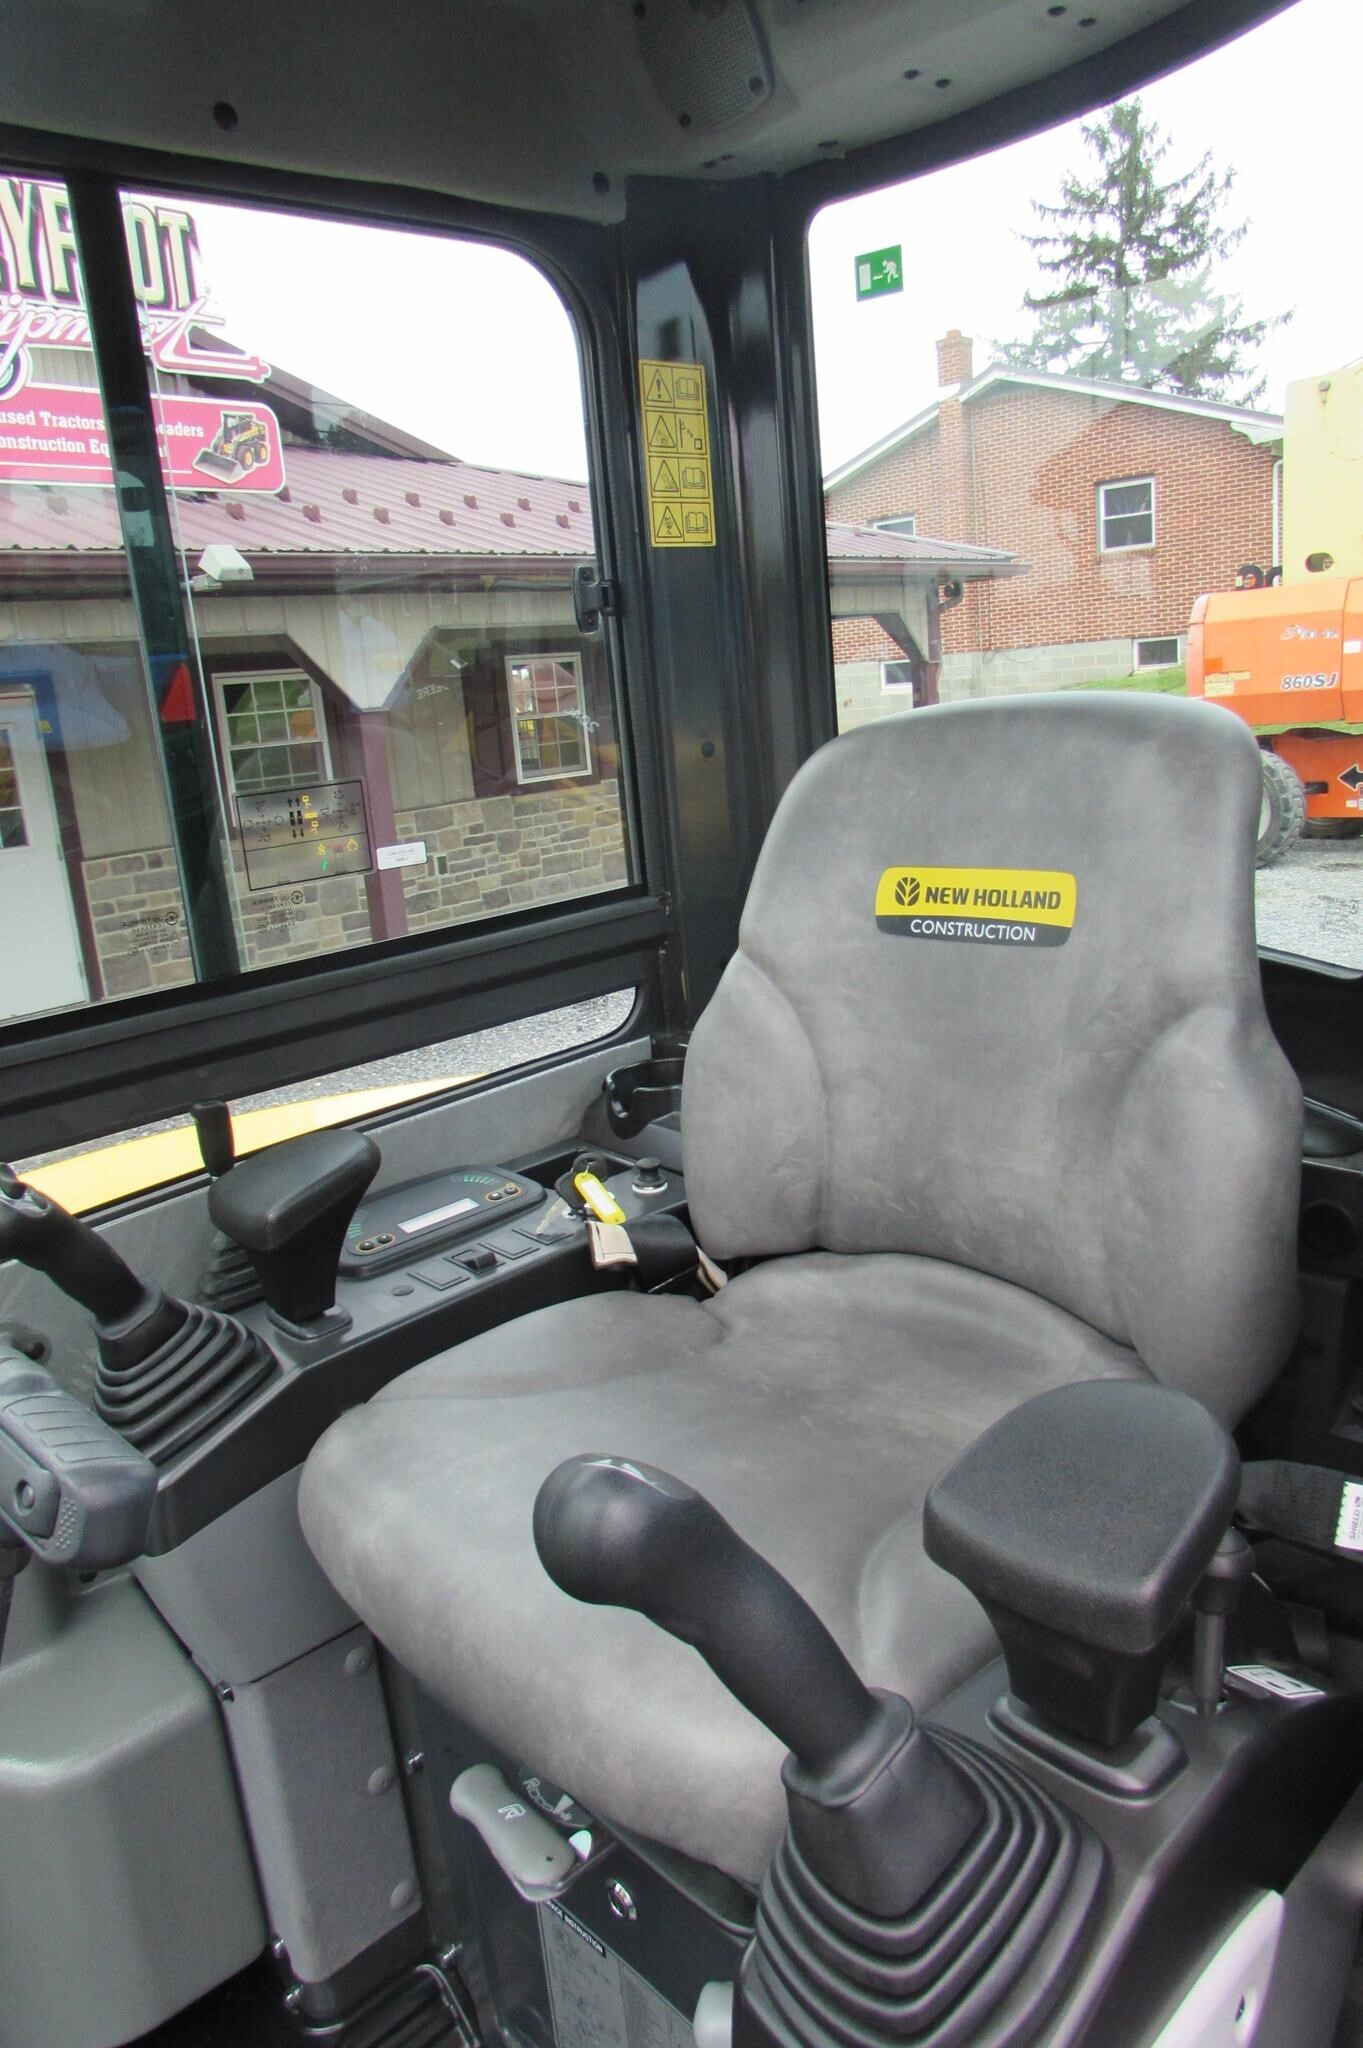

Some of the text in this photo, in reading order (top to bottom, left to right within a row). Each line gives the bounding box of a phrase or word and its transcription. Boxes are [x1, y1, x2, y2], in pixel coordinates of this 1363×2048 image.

[39, 411, 105, 431] Tractors
[0, 435, 86, 454] onstruction
[1281, 673, 1338, 690] 860SJ
[924, 886, 1061, 910] NEW HOLLAND
[910, 919, 1036, 942] CONSTRUCTION
